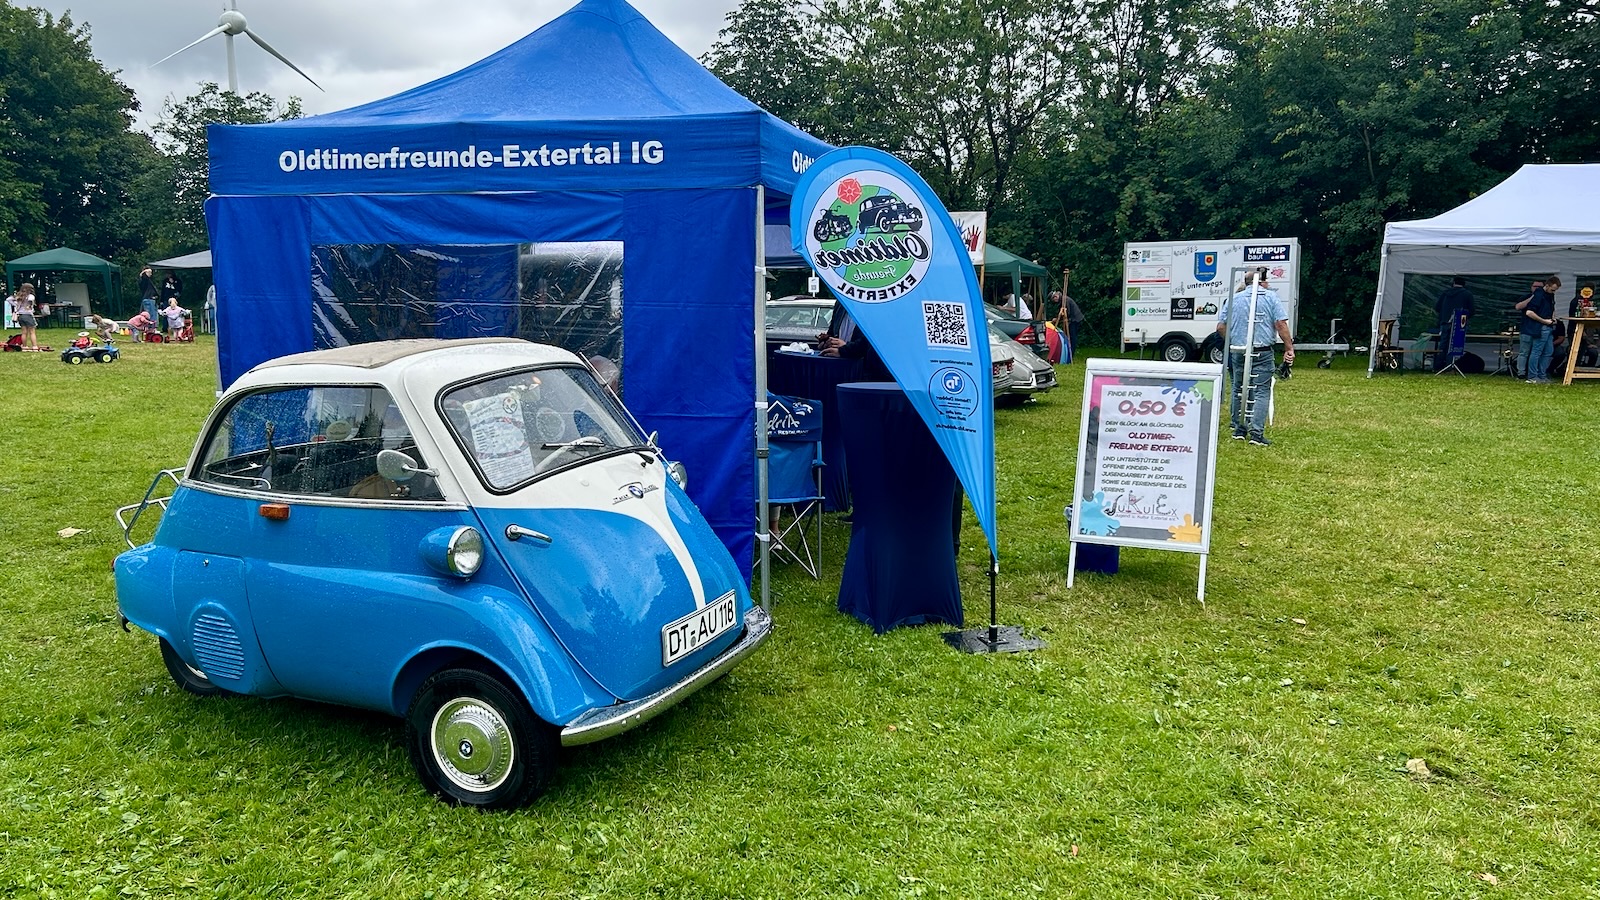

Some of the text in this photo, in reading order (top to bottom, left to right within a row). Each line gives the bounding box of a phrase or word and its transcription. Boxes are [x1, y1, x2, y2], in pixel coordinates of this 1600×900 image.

[278, 140, 665, 172] Oldtimerfreunde-Extertal IG
[1248, 247, 1286, 255] WERPUP
[1187, 281, 1222, 290] unterwegs
[1118, 400, 1187, 416] 0,50 €
[1128, 432, 1176, 440] OLDTIMER-
[1108, 442, 1193, 453] FREUNDE EXTERTAL
[1117, 456, 1159, 464] UNTERSTÜTZE
[719, 600, 733, 628] 118
